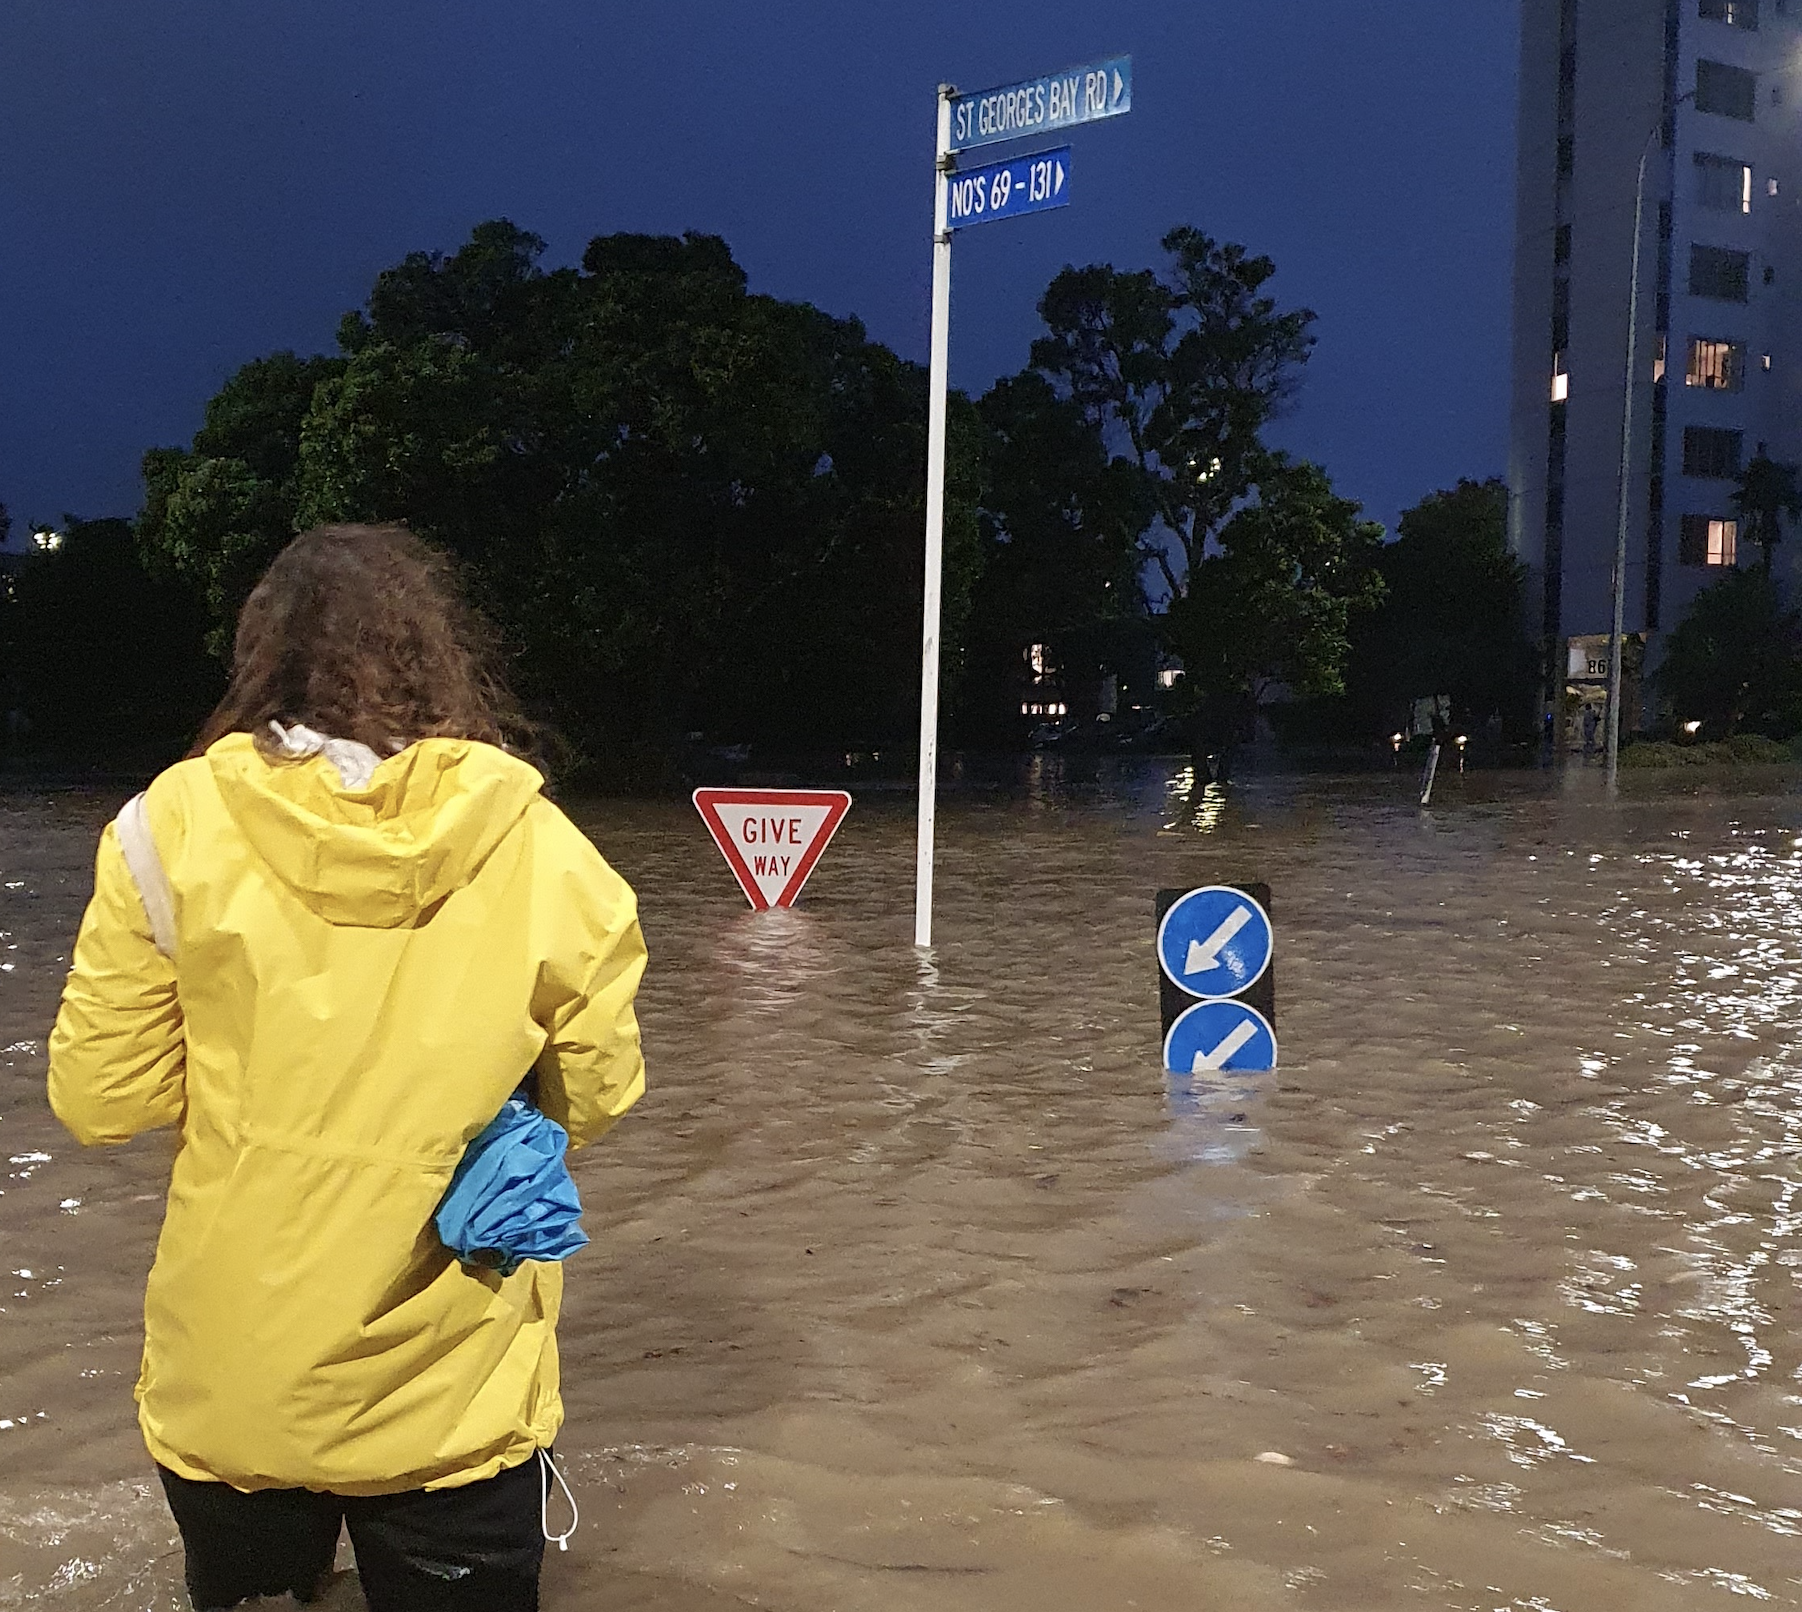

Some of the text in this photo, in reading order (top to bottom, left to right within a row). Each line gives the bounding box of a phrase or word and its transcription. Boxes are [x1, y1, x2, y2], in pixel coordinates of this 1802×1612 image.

[956, 69, 1108, 141] ST GEORGES BAY RD
[951, 176, 986, 218] NO'S
[990, 170, 1012, 210] 69
[1029, 160, 1053, 202] 131
[1588, 660, 1606, 674] 86
[742, 817, 802, 844] GIVE
[754, 856, 790, 876] WAY
